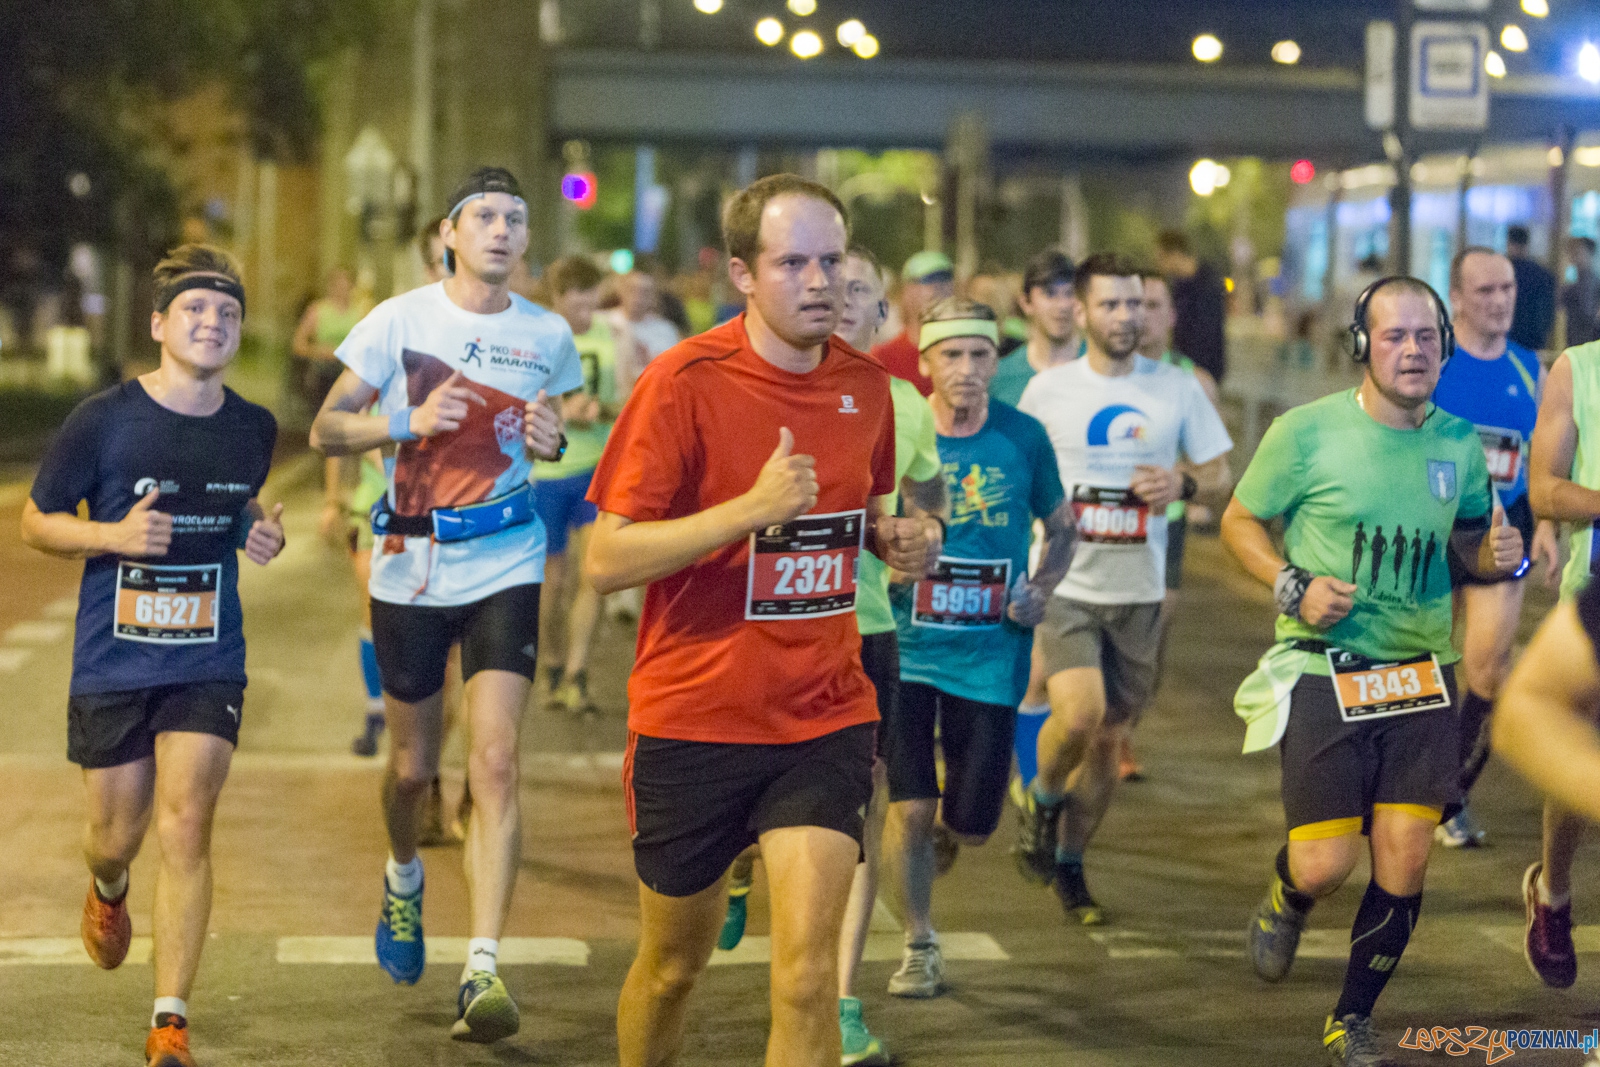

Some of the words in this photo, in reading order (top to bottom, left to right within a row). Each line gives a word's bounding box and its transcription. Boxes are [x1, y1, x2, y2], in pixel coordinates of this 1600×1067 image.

[490, 344, 509, 355] PKO
[490, 356, 551, 374] MARATHON
[773, 553, 843, 595] 2321
[135, 594, 201, 625] 6527
[931, 584, 991, 614] 5951
[1352, 667, 1421, 702] 7343
